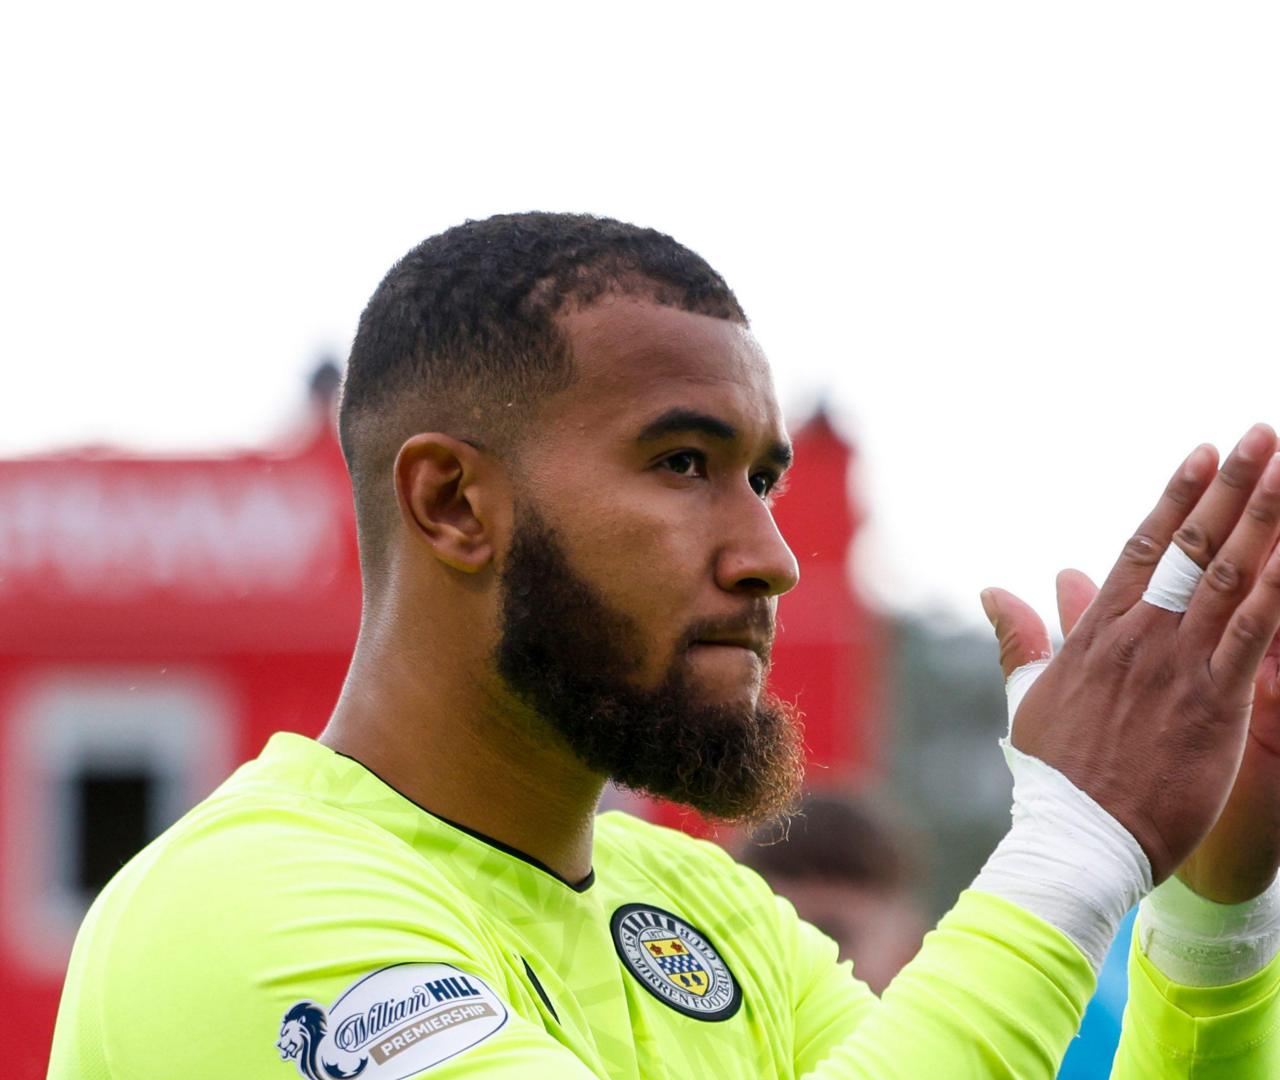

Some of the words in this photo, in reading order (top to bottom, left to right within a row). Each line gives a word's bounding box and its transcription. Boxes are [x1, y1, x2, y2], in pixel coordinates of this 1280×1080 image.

[680, 928, 716, 960] CLUB
[632, 957, 690, 1006] MIRREN
[692, 967, 730, 1009] FOOTBALL
[335, 985, 430, 1052] William
[425, 976, 481, 1003] HILL
[380, 1004, 487, 1057] PREMIERSHIP
